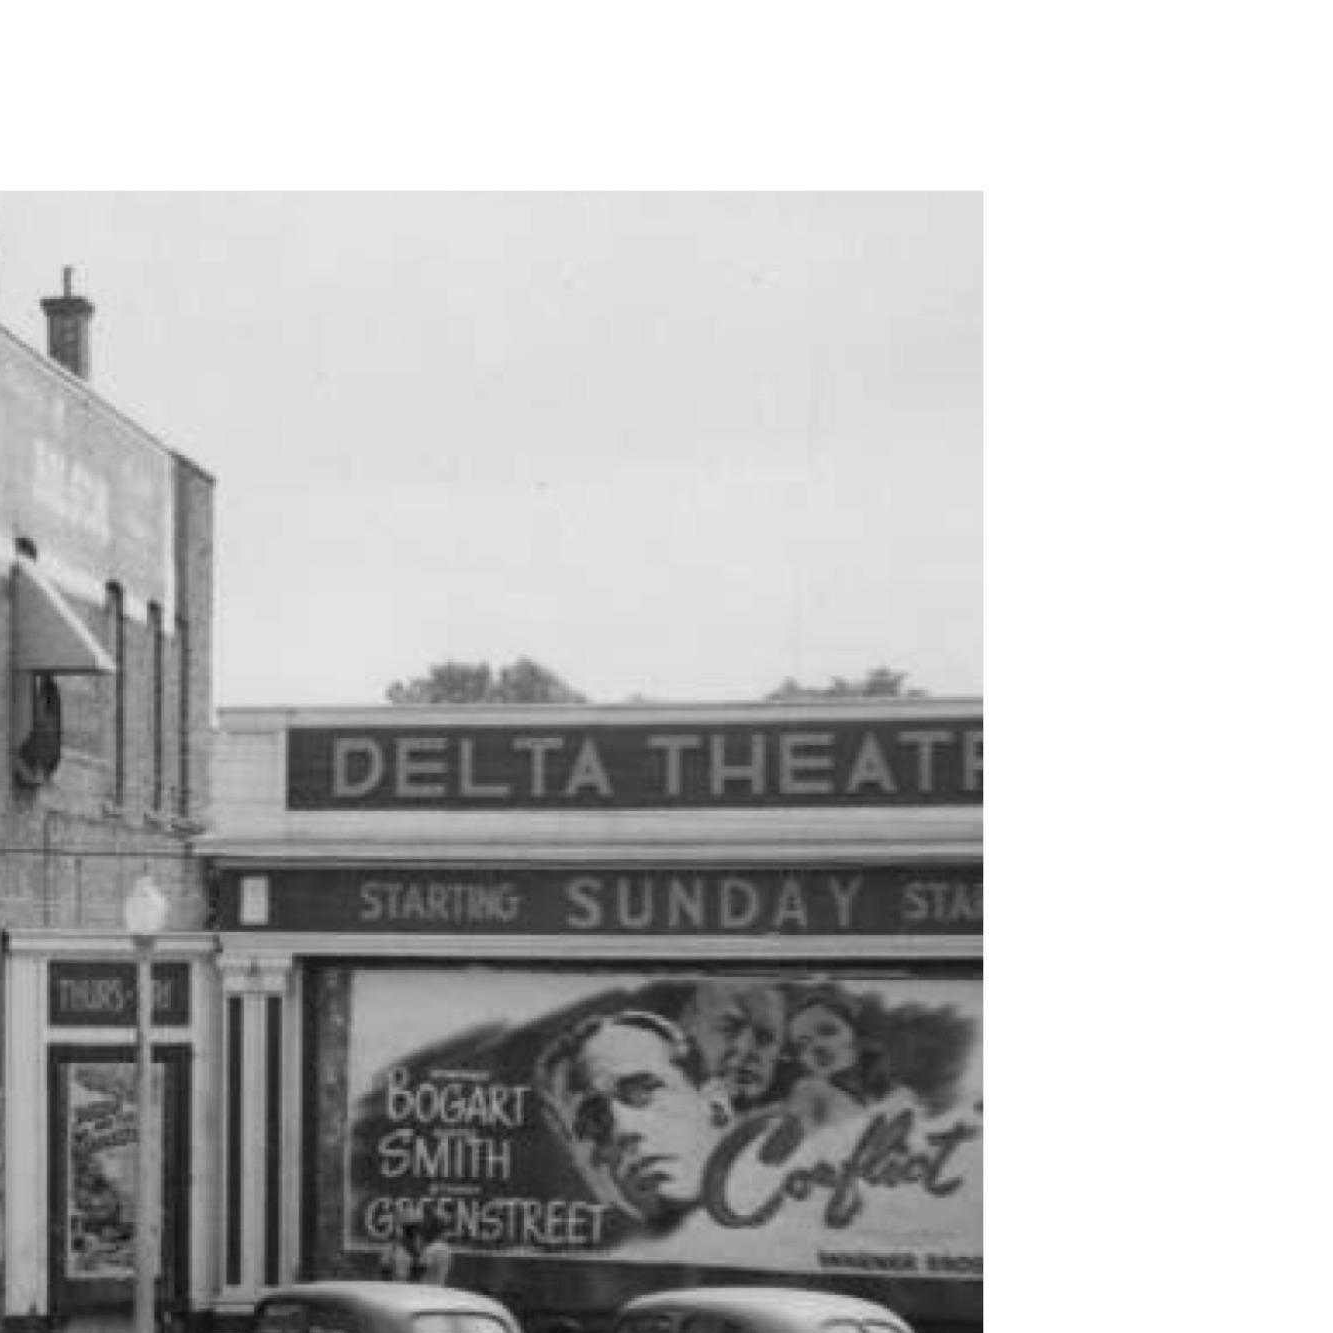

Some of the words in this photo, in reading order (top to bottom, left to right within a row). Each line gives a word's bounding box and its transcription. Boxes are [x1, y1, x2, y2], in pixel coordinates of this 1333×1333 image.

[334, 737, 613, 798] DELTA
[359, 881, 519, 922] STARTING
[566, 877, 863, 928] SUNDAY
[387, 1066, 531, 1126] BOGART
[379, 1127, 510, 1181] SMITH
[703, 1108, 981, 1229] Conflict
